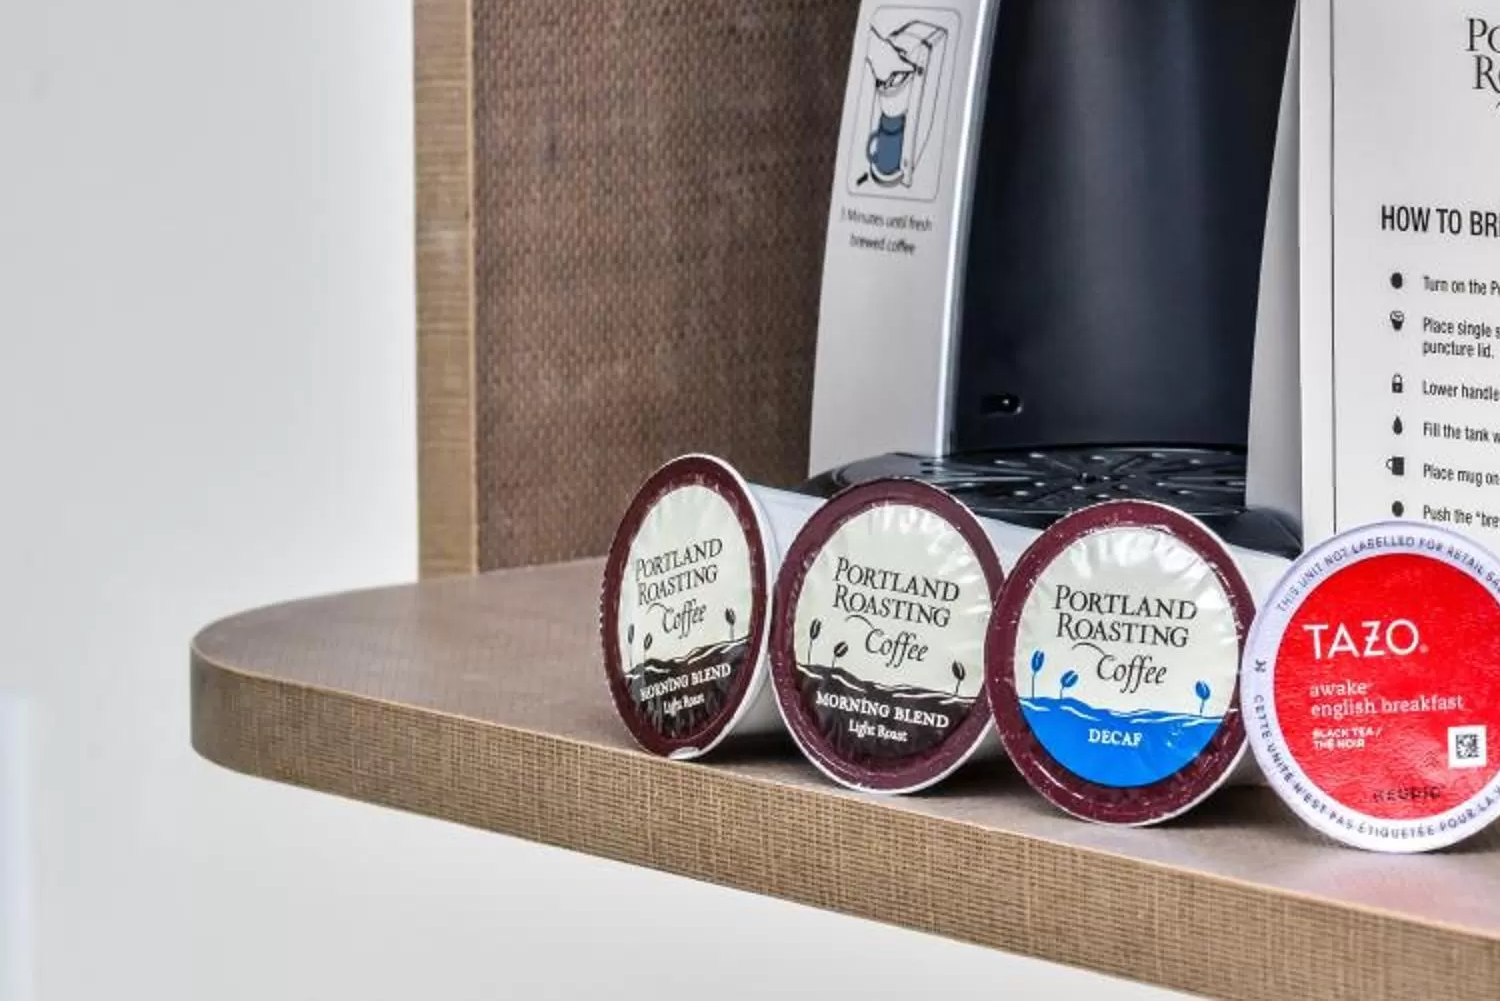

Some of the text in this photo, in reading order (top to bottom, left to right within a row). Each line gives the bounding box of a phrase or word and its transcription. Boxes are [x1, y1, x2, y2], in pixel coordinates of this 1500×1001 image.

[1381, 204, 1431, 233] HOW
[1436, 208, 1462, 234] TO
[1423, 275, 1449, 292] Turn
[1451, 280, 1466, 294] on
[1468, 278, 1487, 296] the
[1423, 316, 1454, 334] Place
[1457, 320, 1492, 340] single
[1423, 340, 1494, 360] puncture lid.
[1422, 380, 1459, 398] Lower
[1461, 384, 1500, 402] handle
[1423, 422, 1440, 437] Fill
[1443, 424, 1461, 440] the
[1465, 426, 1489, 442] tank
[1423, 462, 1454, 480] Place
[1457, 469, 1483, 488] mug
[1485, 473, 1500, 486] on
[1423, 504, 1451, 522] Push
[1454, 509, 1473, 525] the
[636, 538, 723, 583] PORTLAND
[1276, 585, 1301, 612] THIS
[1299, 561, 1323, 588] UNIT
[1323, 547, 1348, 566] NOT
[1350, 536, 1415, 555] LABELLED
[1419, 536, 1445, 552] FOR
[637, 564, 718, 608] ROASTING
[833, 556, 961, 603] PORTLAND
[833, 583, 951, 628] ROASTING
[1052, 584, 1198, 621] PORTLAND
[655, 599, 707, 640] Coffee
[1056, 613, 1190, 649] ROASTING
[856, 621, 929, 668] Coffee
[1302, 618, 1420, 661] TAZO
[640, 663, 731, 702] MORNING BLEND
[1085, 649, 1168, 694] Coffee
[1310, 679, 1368, 698] awake
[815, 690, 949, 729] MORNING BLEND
[1253, 693, 1273, 740] CETTE
[1311, 695, 1464, 720] english breakfast
[848, 719, 910, 743] Light Roast
[1087, 728, 1143, 748] DECAF
[1312, 727, 1348, 738] BLACK
[1336, 738, 1366, 750] NOIR
